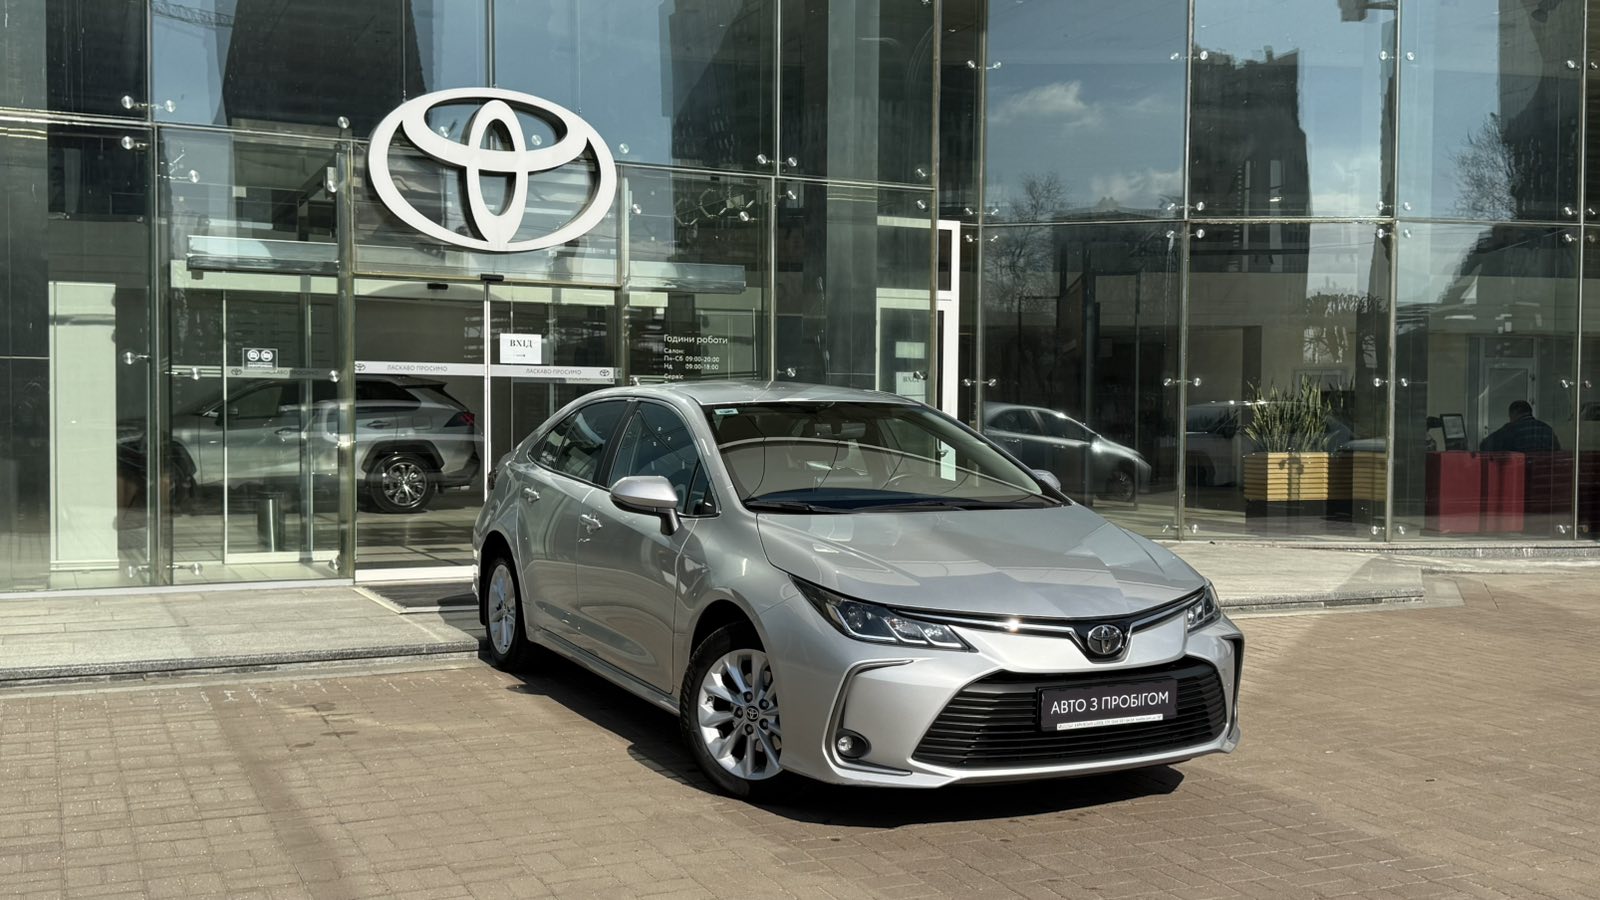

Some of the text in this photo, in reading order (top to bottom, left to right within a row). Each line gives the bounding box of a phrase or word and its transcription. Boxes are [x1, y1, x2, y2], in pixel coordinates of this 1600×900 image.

[509, 339, 533, 349] ВХІД
[663, 334, 728, 345] Години роботи
[525, 367, 552, 375] ЛАСКАВО
[1050, 698, 1086, 714] АВТО
[1101, 691, 1168, 710] ПРОБІГОМ
